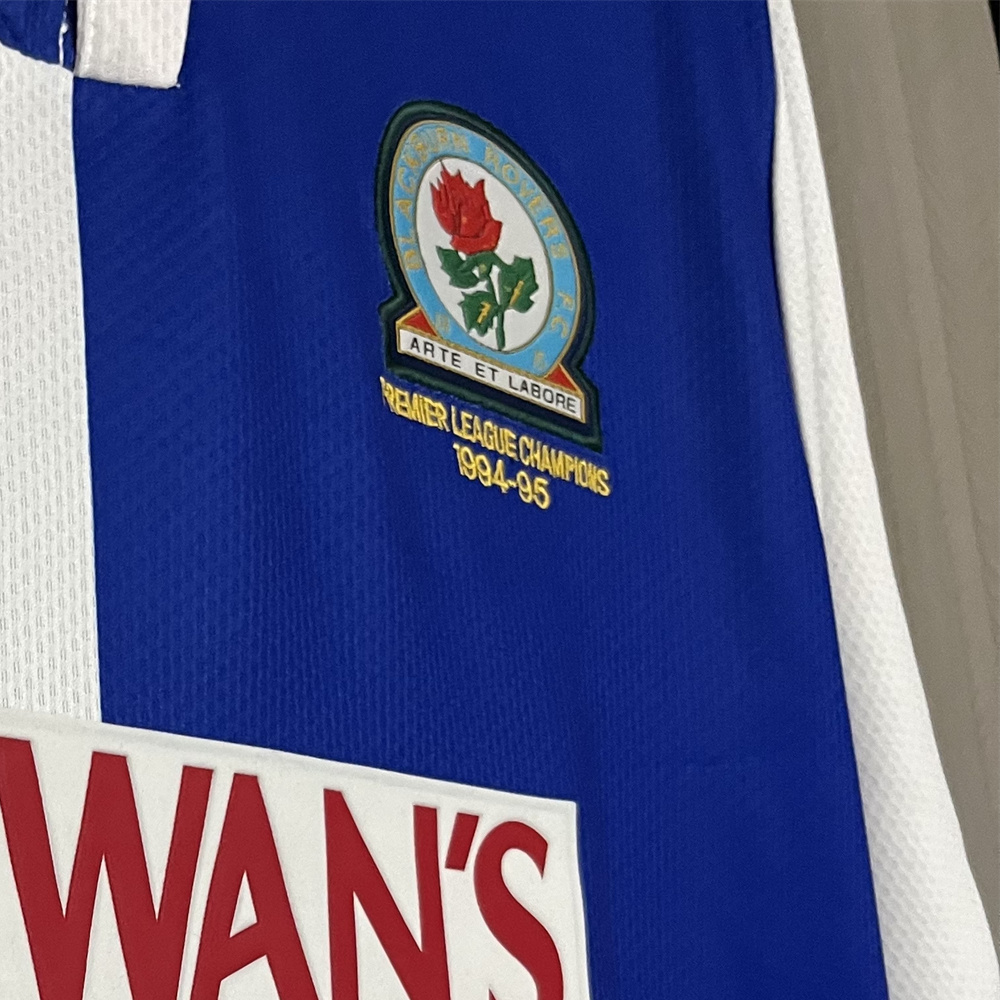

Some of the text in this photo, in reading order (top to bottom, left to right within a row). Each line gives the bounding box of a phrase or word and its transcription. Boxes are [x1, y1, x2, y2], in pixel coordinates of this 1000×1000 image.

[410, 337, 462, 369] ARTE
[475, 361, 500, 382] ET
[509, 375, 578, 414] LABORE
[379, 375, 612, 497] PREMIER LEAGUE CHAMPIONS
[452, 442, 551, 510] 1994-95
